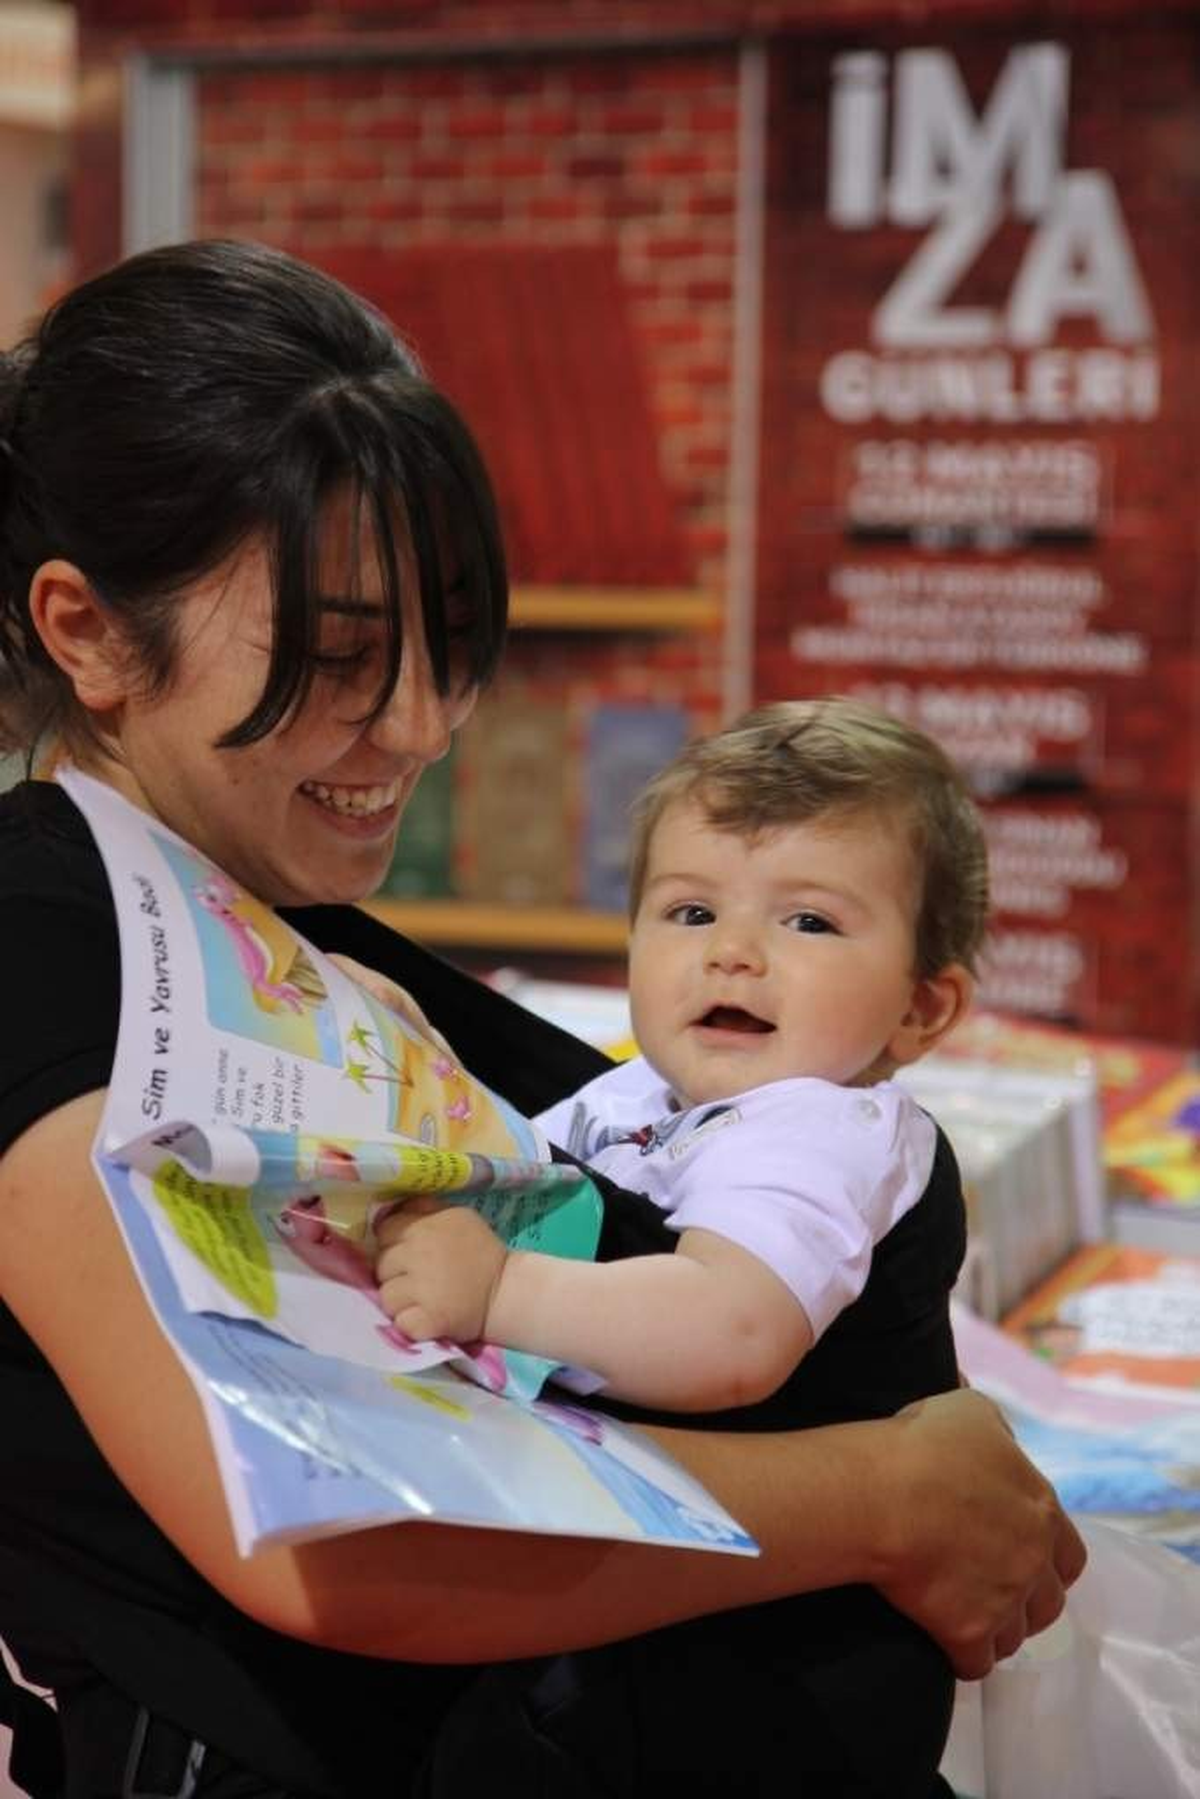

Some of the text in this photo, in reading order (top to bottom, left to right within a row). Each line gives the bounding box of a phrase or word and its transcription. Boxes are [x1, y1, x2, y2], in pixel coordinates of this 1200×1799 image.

[150, 924, 171, 1014] Yavrusu
[154, 1027, 171, 1055] ve
[141, 1068, 168, 1121] Sim
